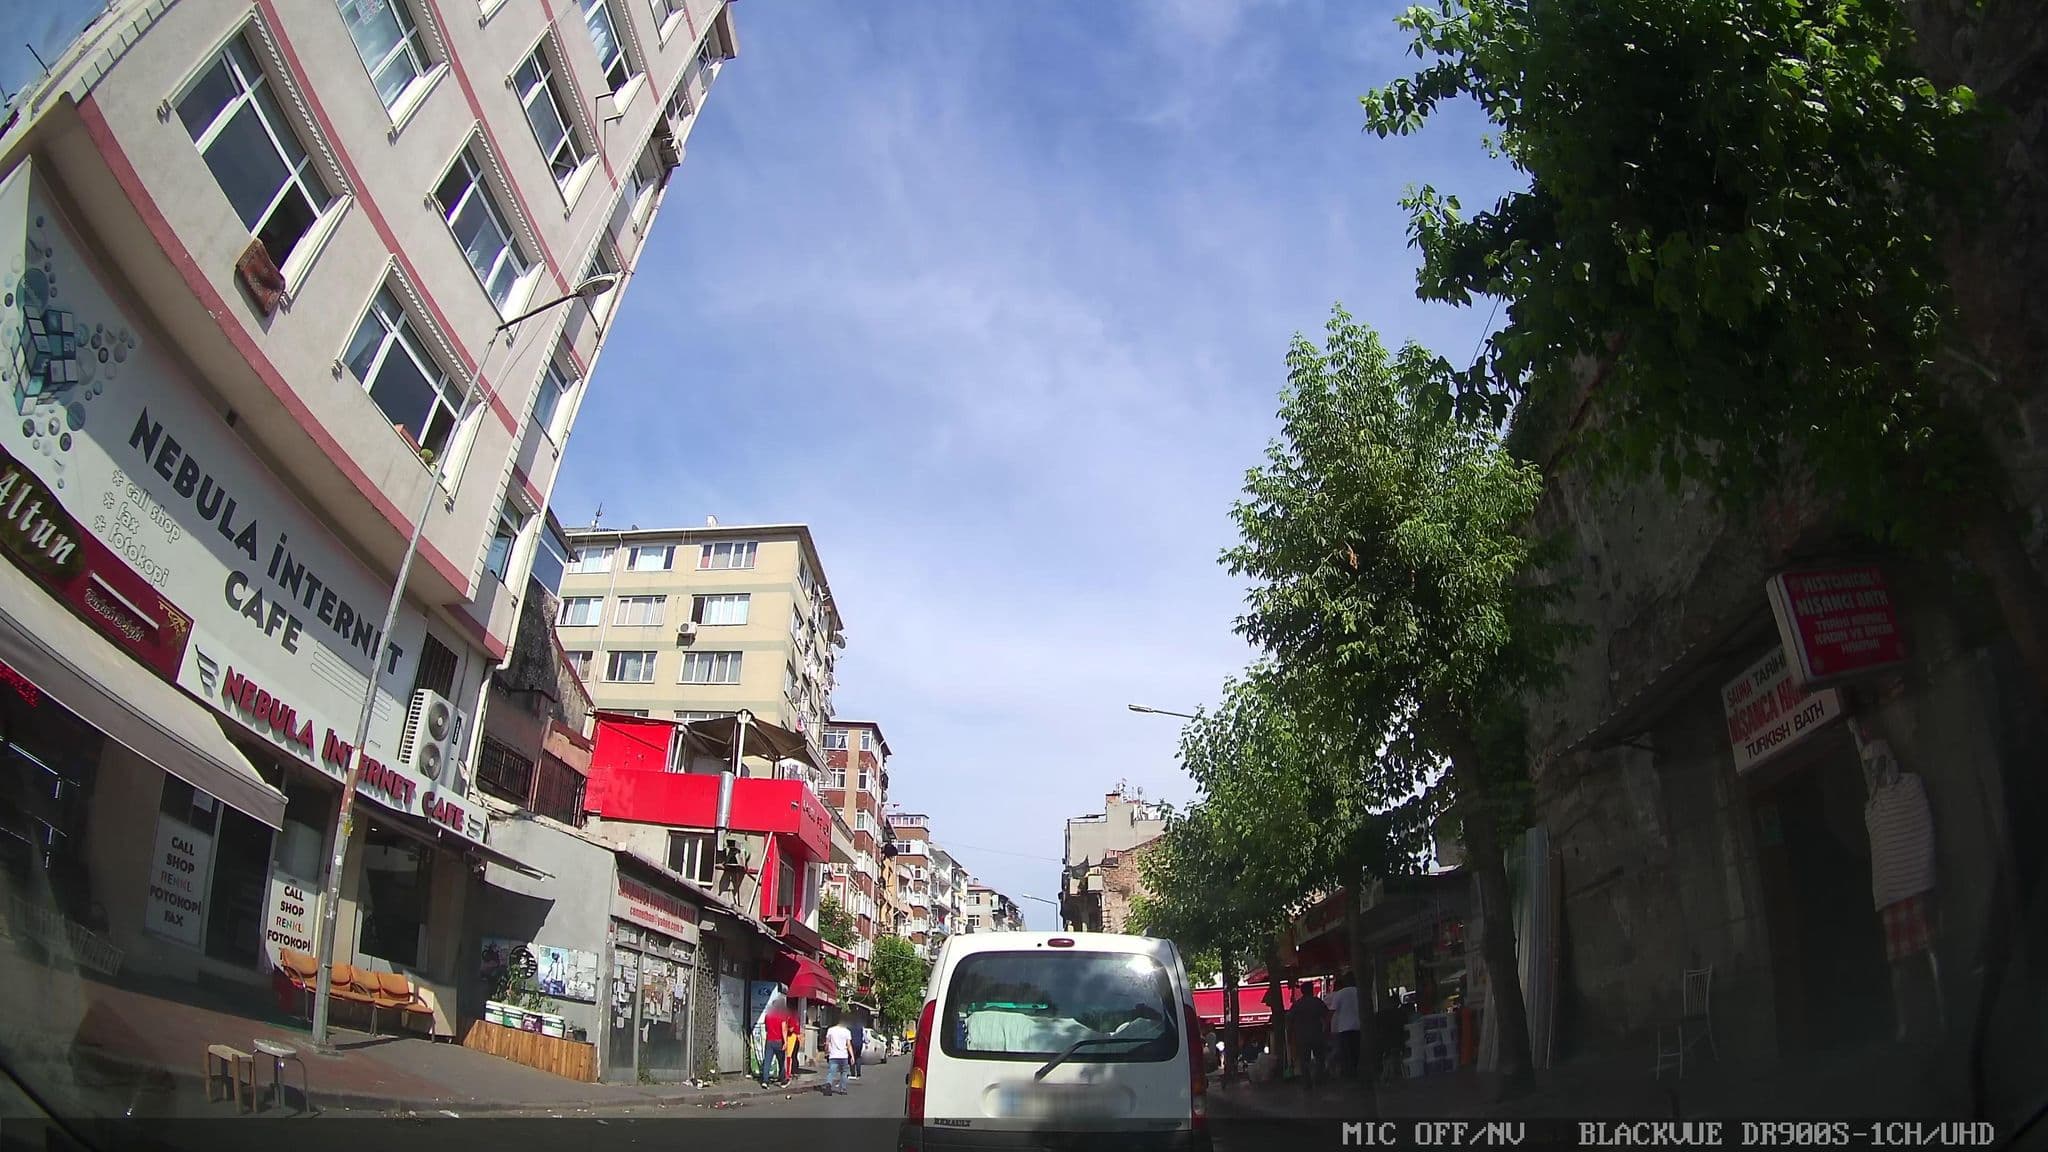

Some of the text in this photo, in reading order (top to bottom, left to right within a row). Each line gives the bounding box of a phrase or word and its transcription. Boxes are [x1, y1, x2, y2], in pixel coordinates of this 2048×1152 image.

[126, 483, 181, 544] call shop
[128, 406, 258, 561] NEBULA
[0, 472, 76, 565] Altun
[116, 501, 140, 535] fax
[108, 522, 170, 587] fotokopi
[224, 570, 303, 655] CAFE
[221, 665, 315, 755] NEBULA
[421, 791, 465, 833] CAFE
[1745, 699, 1825, 759] TURKISH BATH
[166, 852, 195, 874] SHOP
[171, 836, 195, 857] CALL
[280, 900, 305, 917] SHOP
[284, 885, 304, 902] CALL
